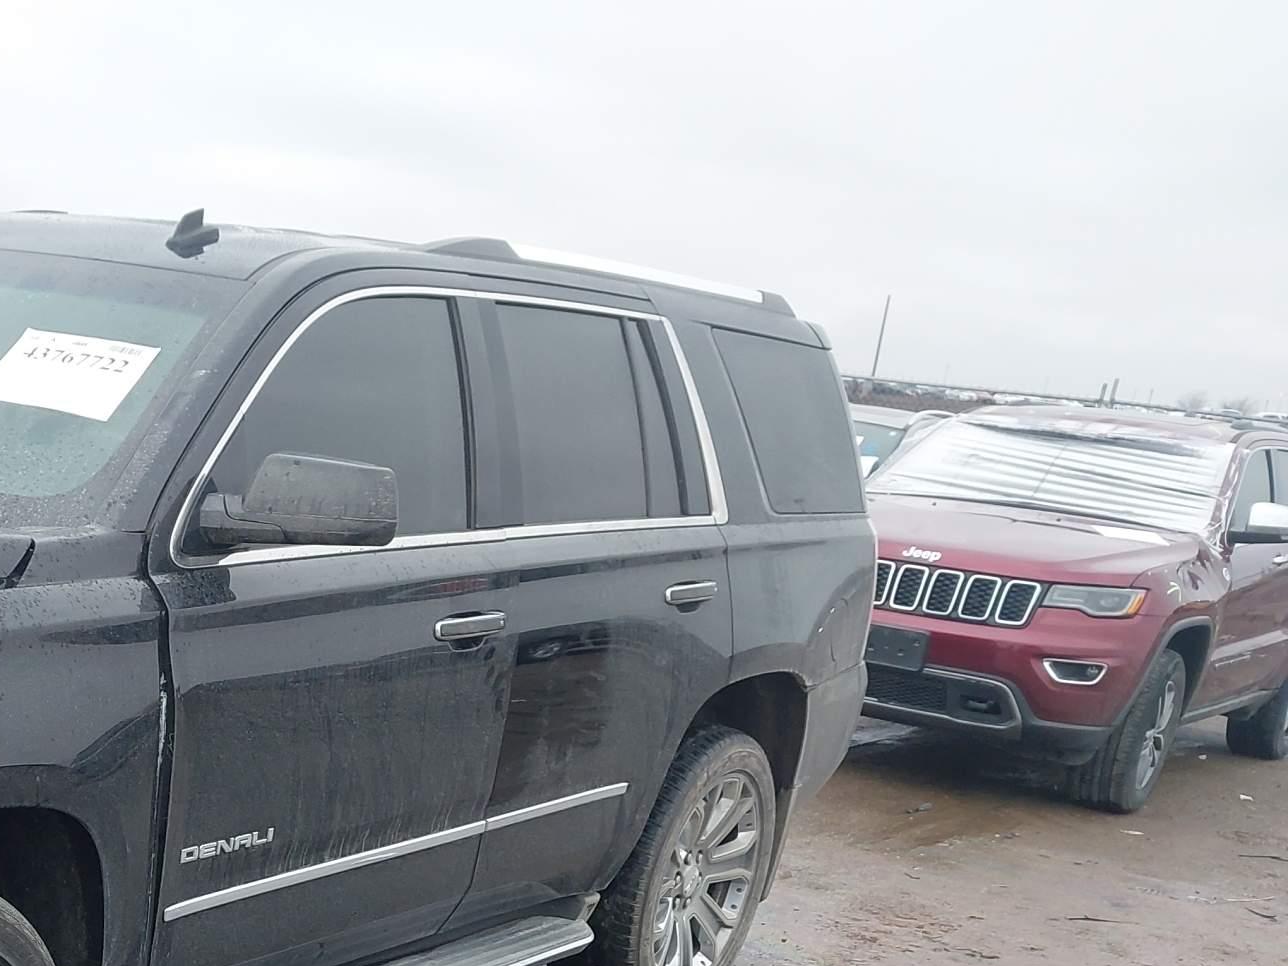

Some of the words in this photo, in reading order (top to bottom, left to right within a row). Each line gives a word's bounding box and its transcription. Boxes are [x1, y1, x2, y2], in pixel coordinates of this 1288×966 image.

[23, 346, 129, 373] 43767722
[902, 546, 942, 562] Jeep
[180, 827, 274, 864] DENALI
